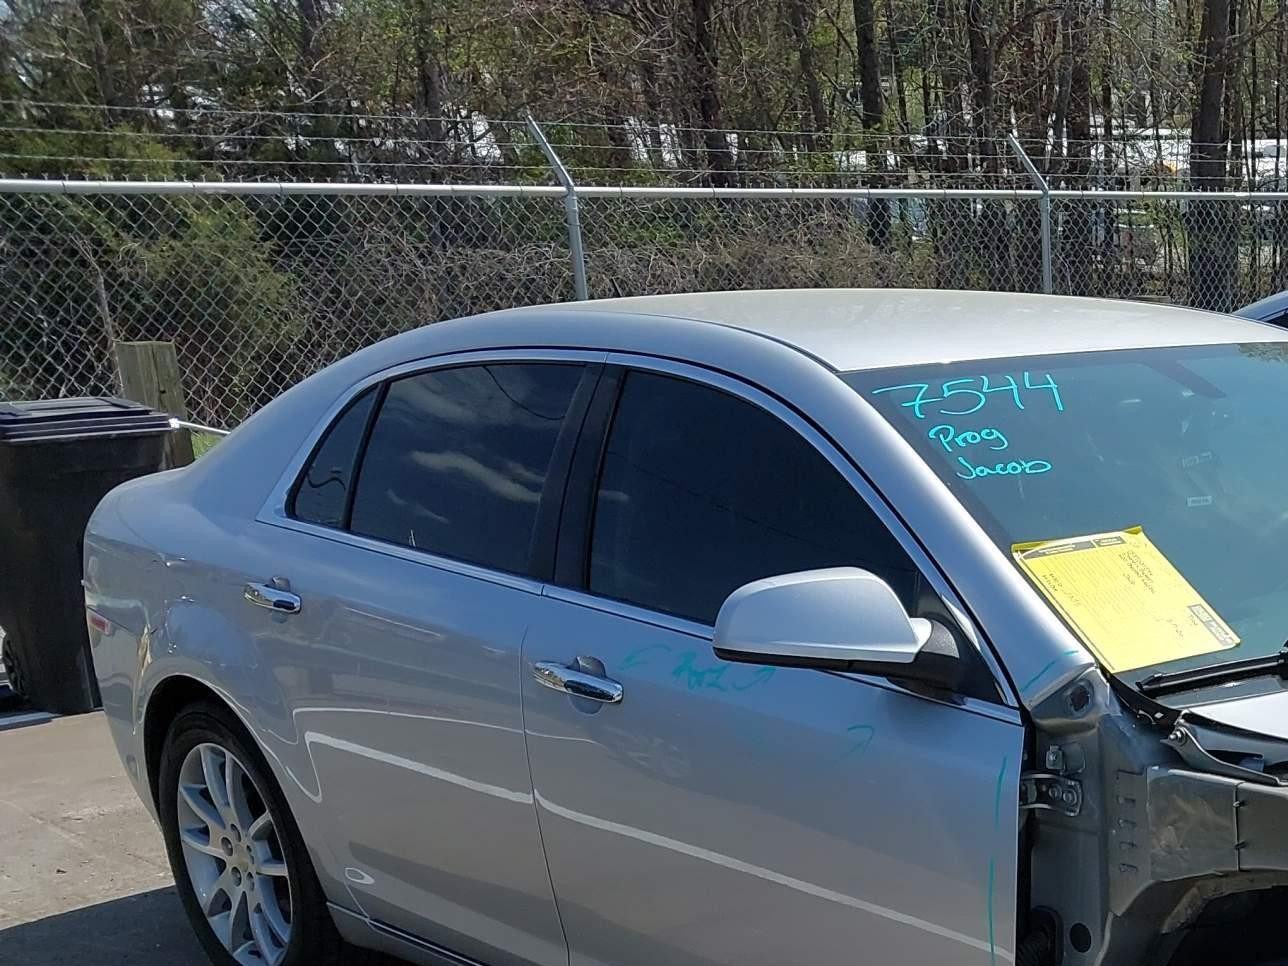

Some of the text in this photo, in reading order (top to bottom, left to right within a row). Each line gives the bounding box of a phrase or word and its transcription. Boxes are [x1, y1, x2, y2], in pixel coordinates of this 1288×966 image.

[872, 371, 1065, 418] 7544
[928, 424, 1009, 452] Prog
[955, 456, 1052, 480] Jacob
